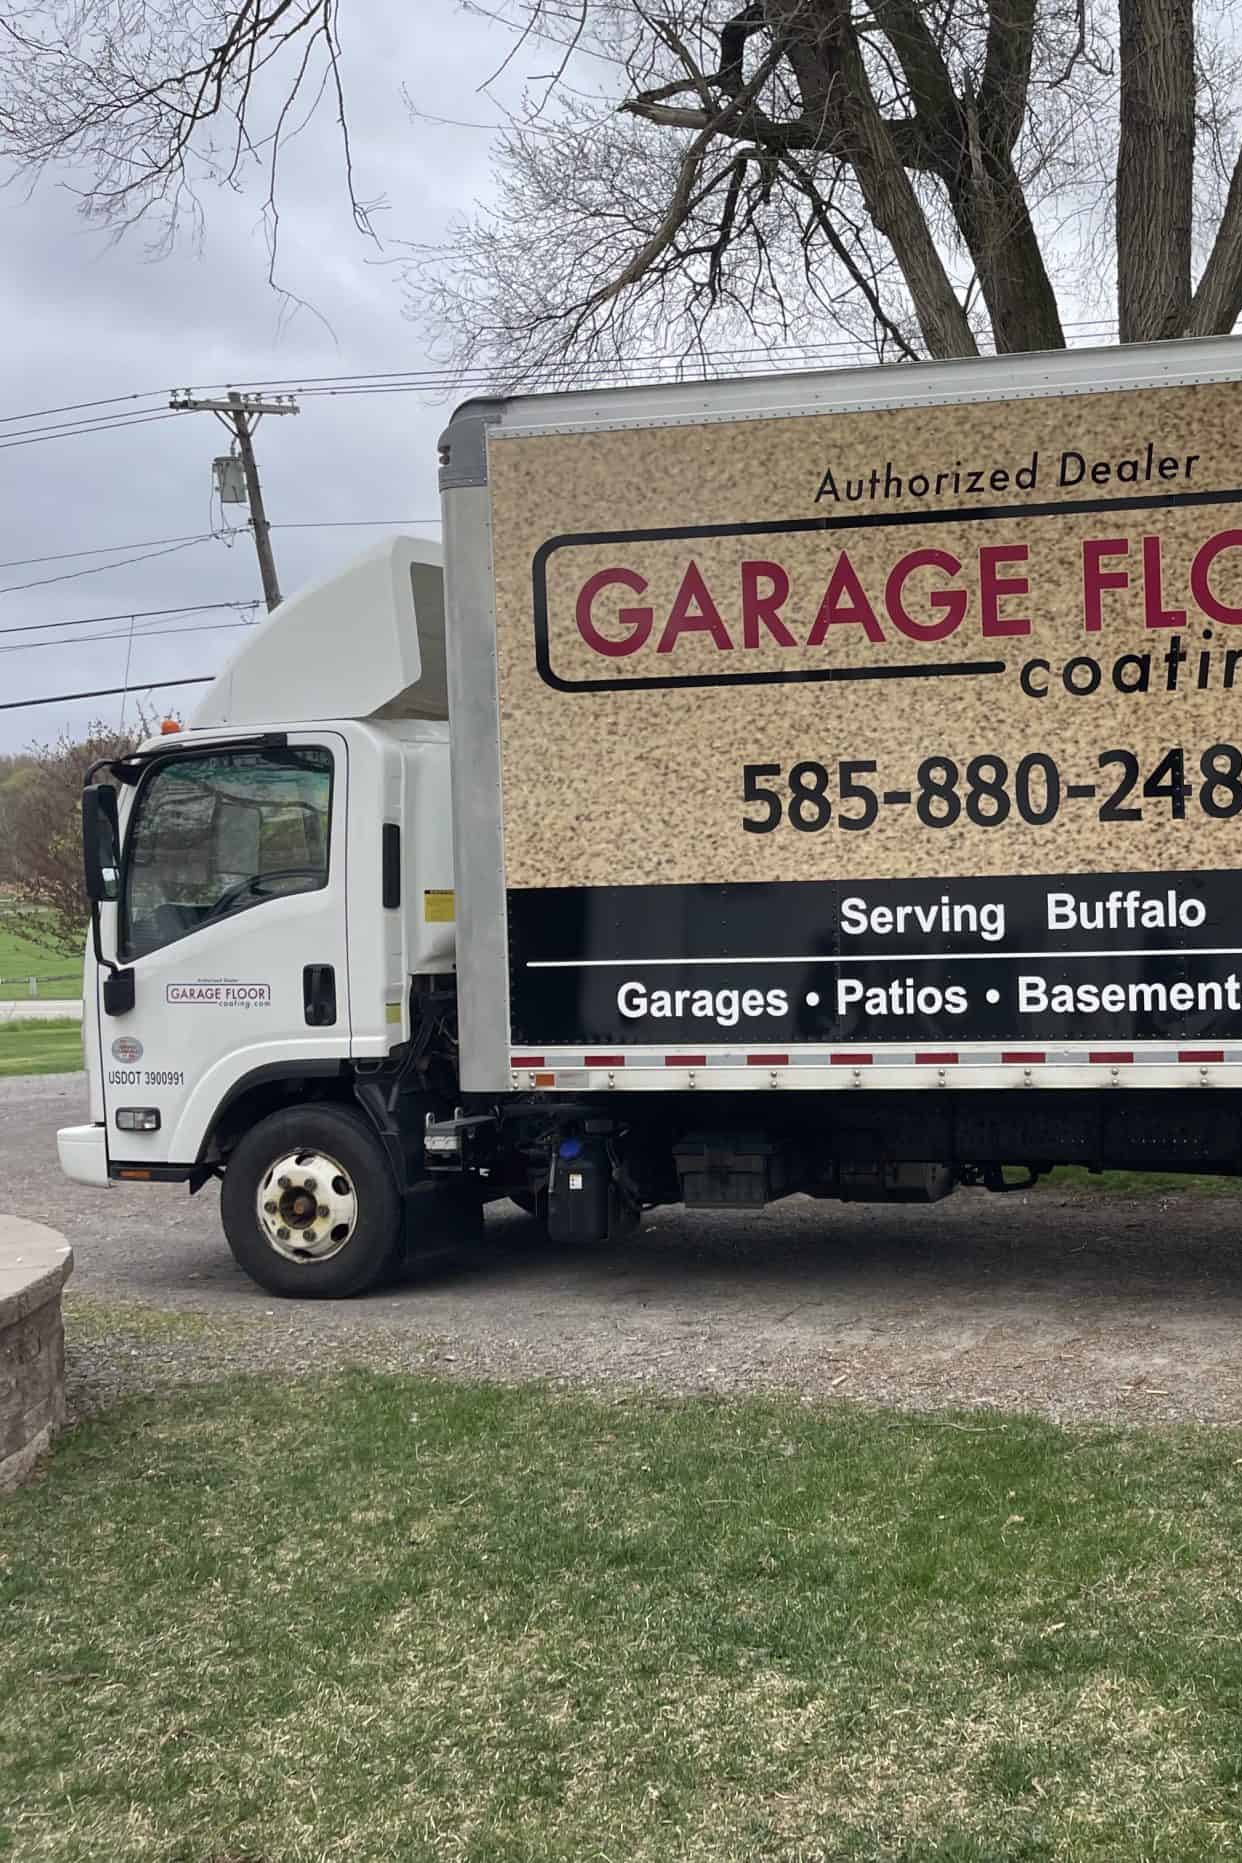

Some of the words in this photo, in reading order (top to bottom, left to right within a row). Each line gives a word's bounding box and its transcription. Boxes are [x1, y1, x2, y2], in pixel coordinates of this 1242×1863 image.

[814, 450, 1039, 504] Authorized
[1059, 442, 1199, 488] Dealer
[576, 545, 1031, 657] GARAGE
[840, 895, 1005, 941] Serving
[1047, 889, 1206, 930] Buffalo
[170, 987, 221, 1000] GARAGE
[225, 987, 265, 1000] FLOOR
[617, 981, 789, 1026] Garages
[837, 978, 968, 1015] Patios
[108, 1071, 141, 1085] USDOT
[144, 1071, 184, 1085] 3900991
